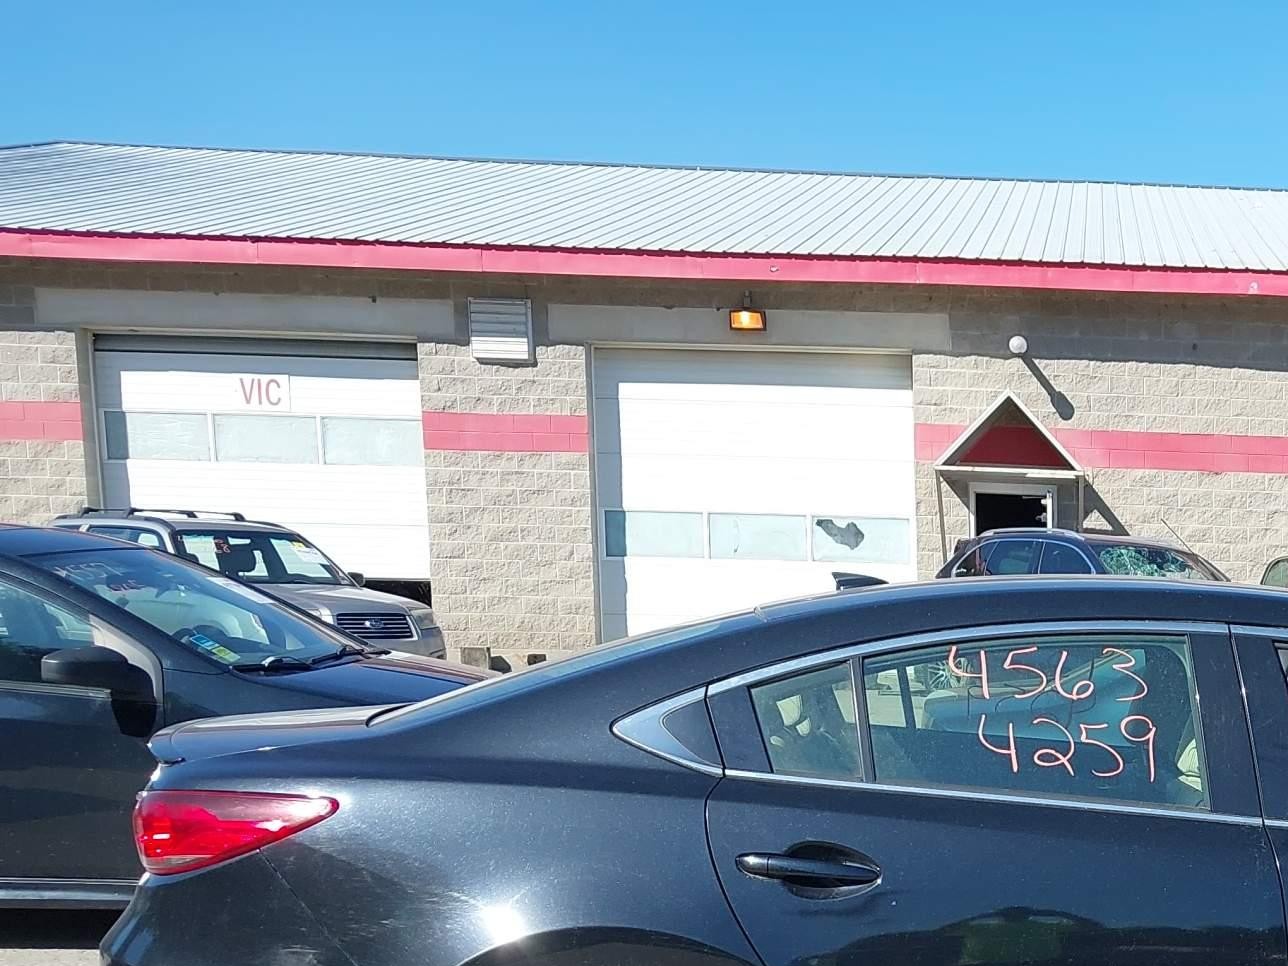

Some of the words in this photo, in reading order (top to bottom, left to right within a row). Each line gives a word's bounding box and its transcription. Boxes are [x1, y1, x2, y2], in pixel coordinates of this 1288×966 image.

[239, 377, 282, 406] VIC
[948, 646, 1148, 700] 4563
[978, 715, 1157, 782] 4259
